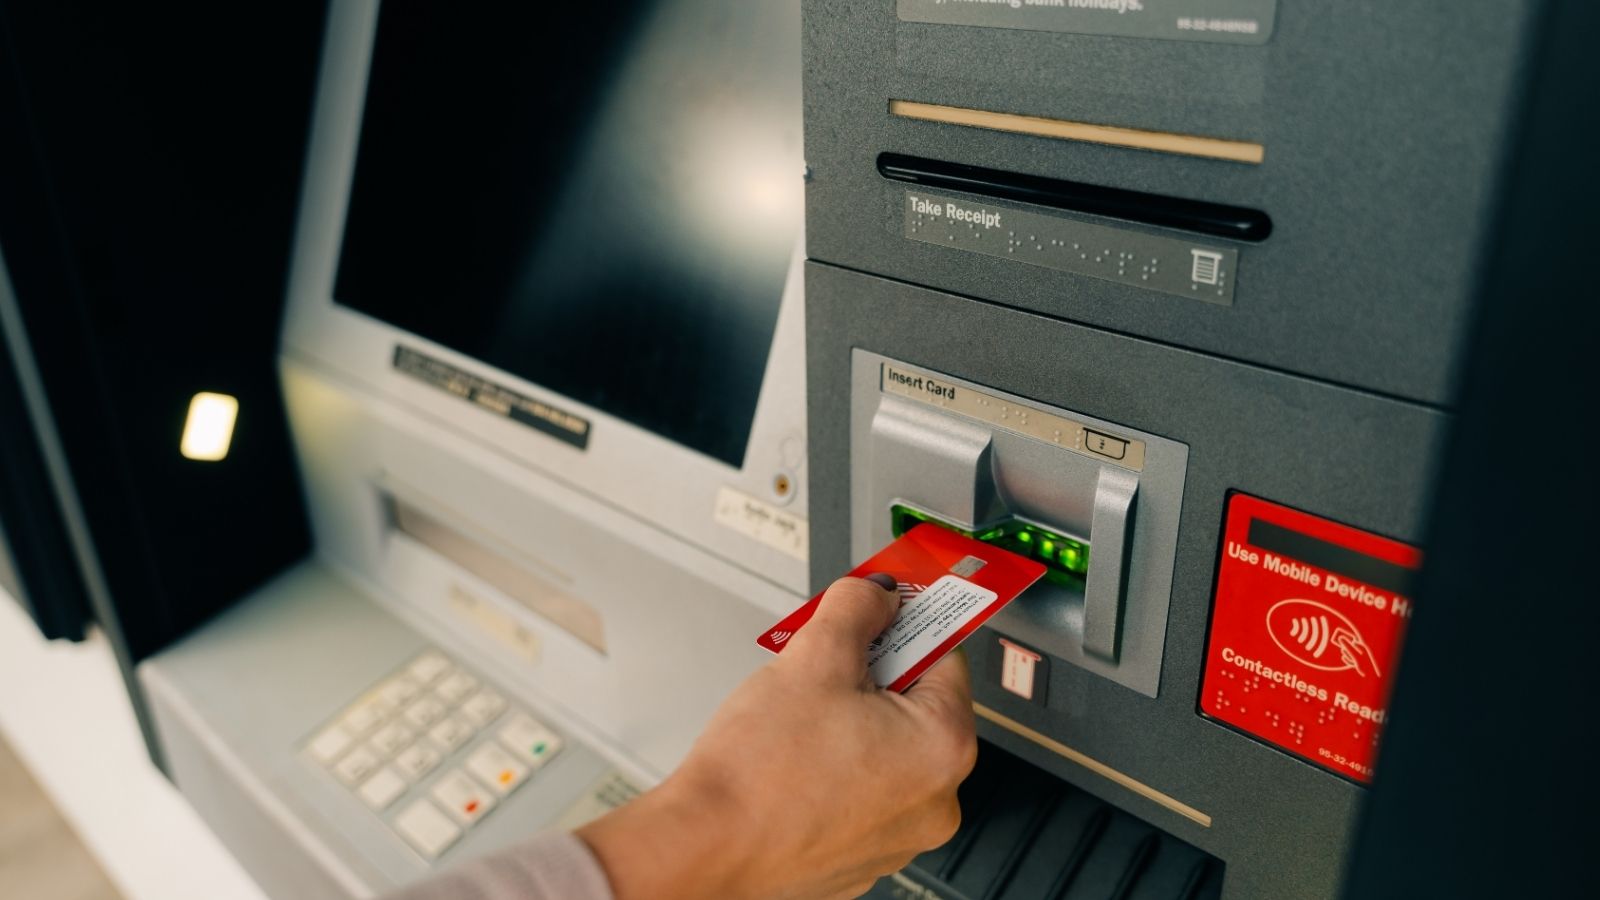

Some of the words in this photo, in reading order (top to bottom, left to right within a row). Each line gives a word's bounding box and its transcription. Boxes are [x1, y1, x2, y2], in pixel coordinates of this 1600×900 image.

[910, 196, 942, 216] Take
[946, 203, 1001, 229] Receipt
[889, 368, 923, 390] Insert
[926, 380, 955, 400] Card
[1228, 541, 1259, 565] Use
[1263, 554, 1321, 587] Mobile
[1324, 575, 1387, 610] Device
[1222, 647, 1328, 702] Contactless
[1333, 691, 1389, 725] Read
